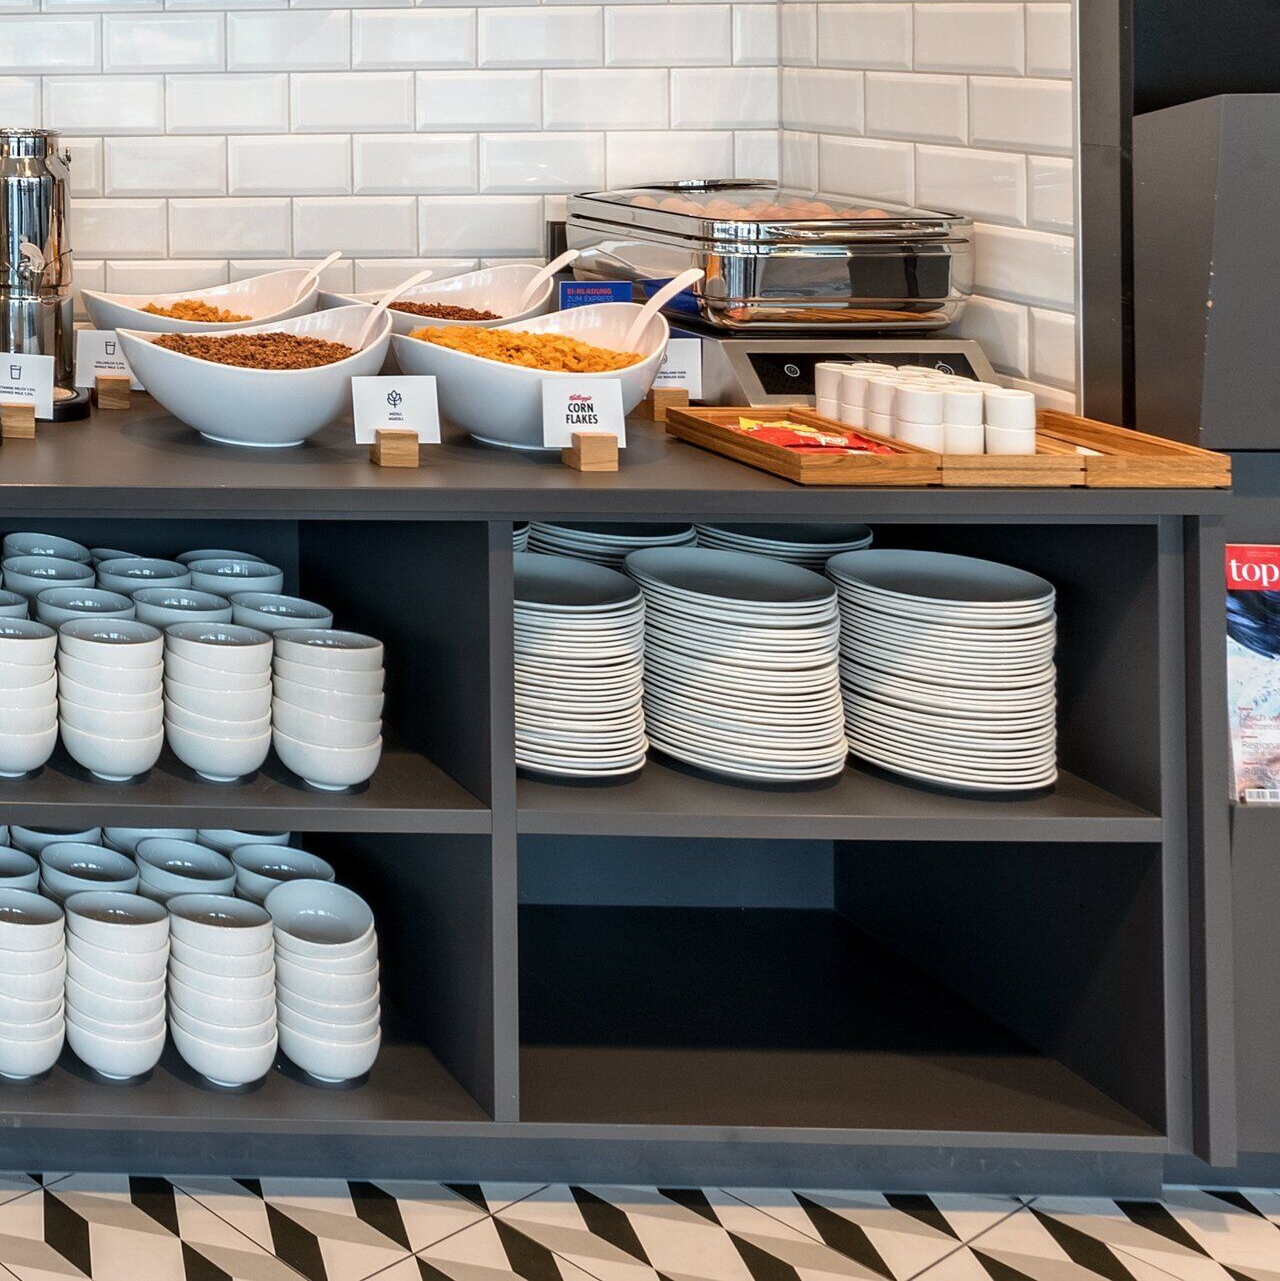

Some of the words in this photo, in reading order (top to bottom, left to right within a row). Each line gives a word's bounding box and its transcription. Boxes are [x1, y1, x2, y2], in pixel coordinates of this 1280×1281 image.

[567, 402, 594, 414] CORN
[565, 413, 599, 425] FLAKES
[1229, 559, 1280, 587] top
